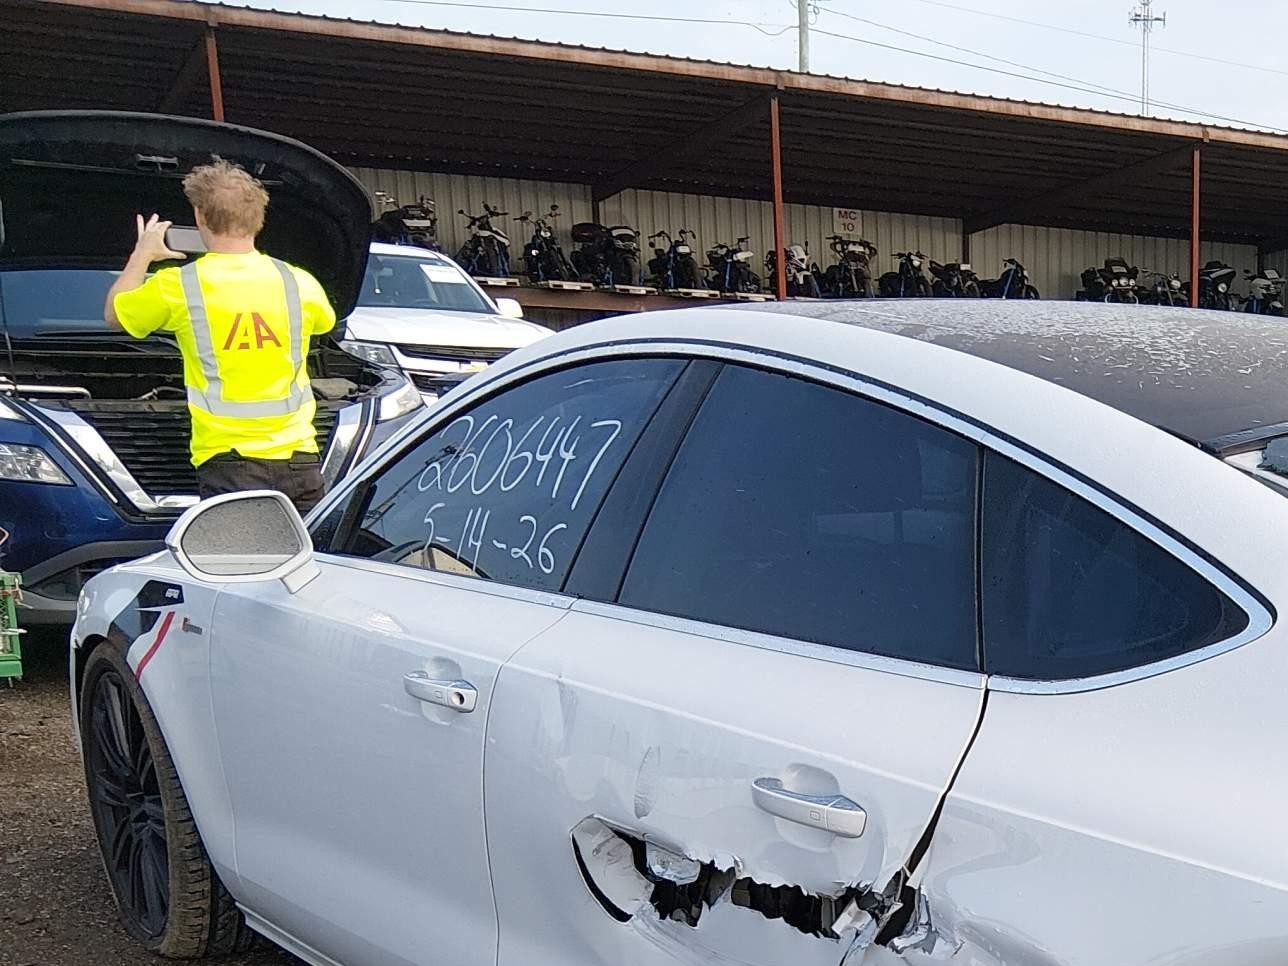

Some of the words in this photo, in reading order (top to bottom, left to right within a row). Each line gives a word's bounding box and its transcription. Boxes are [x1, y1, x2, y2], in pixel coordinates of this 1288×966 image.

[838, 210, 857, 221] MC
[841, 222, 855, 232] 10
[417, 414, 622, 511] 2606447
[423, 502, 568, 575] 5-14-26
